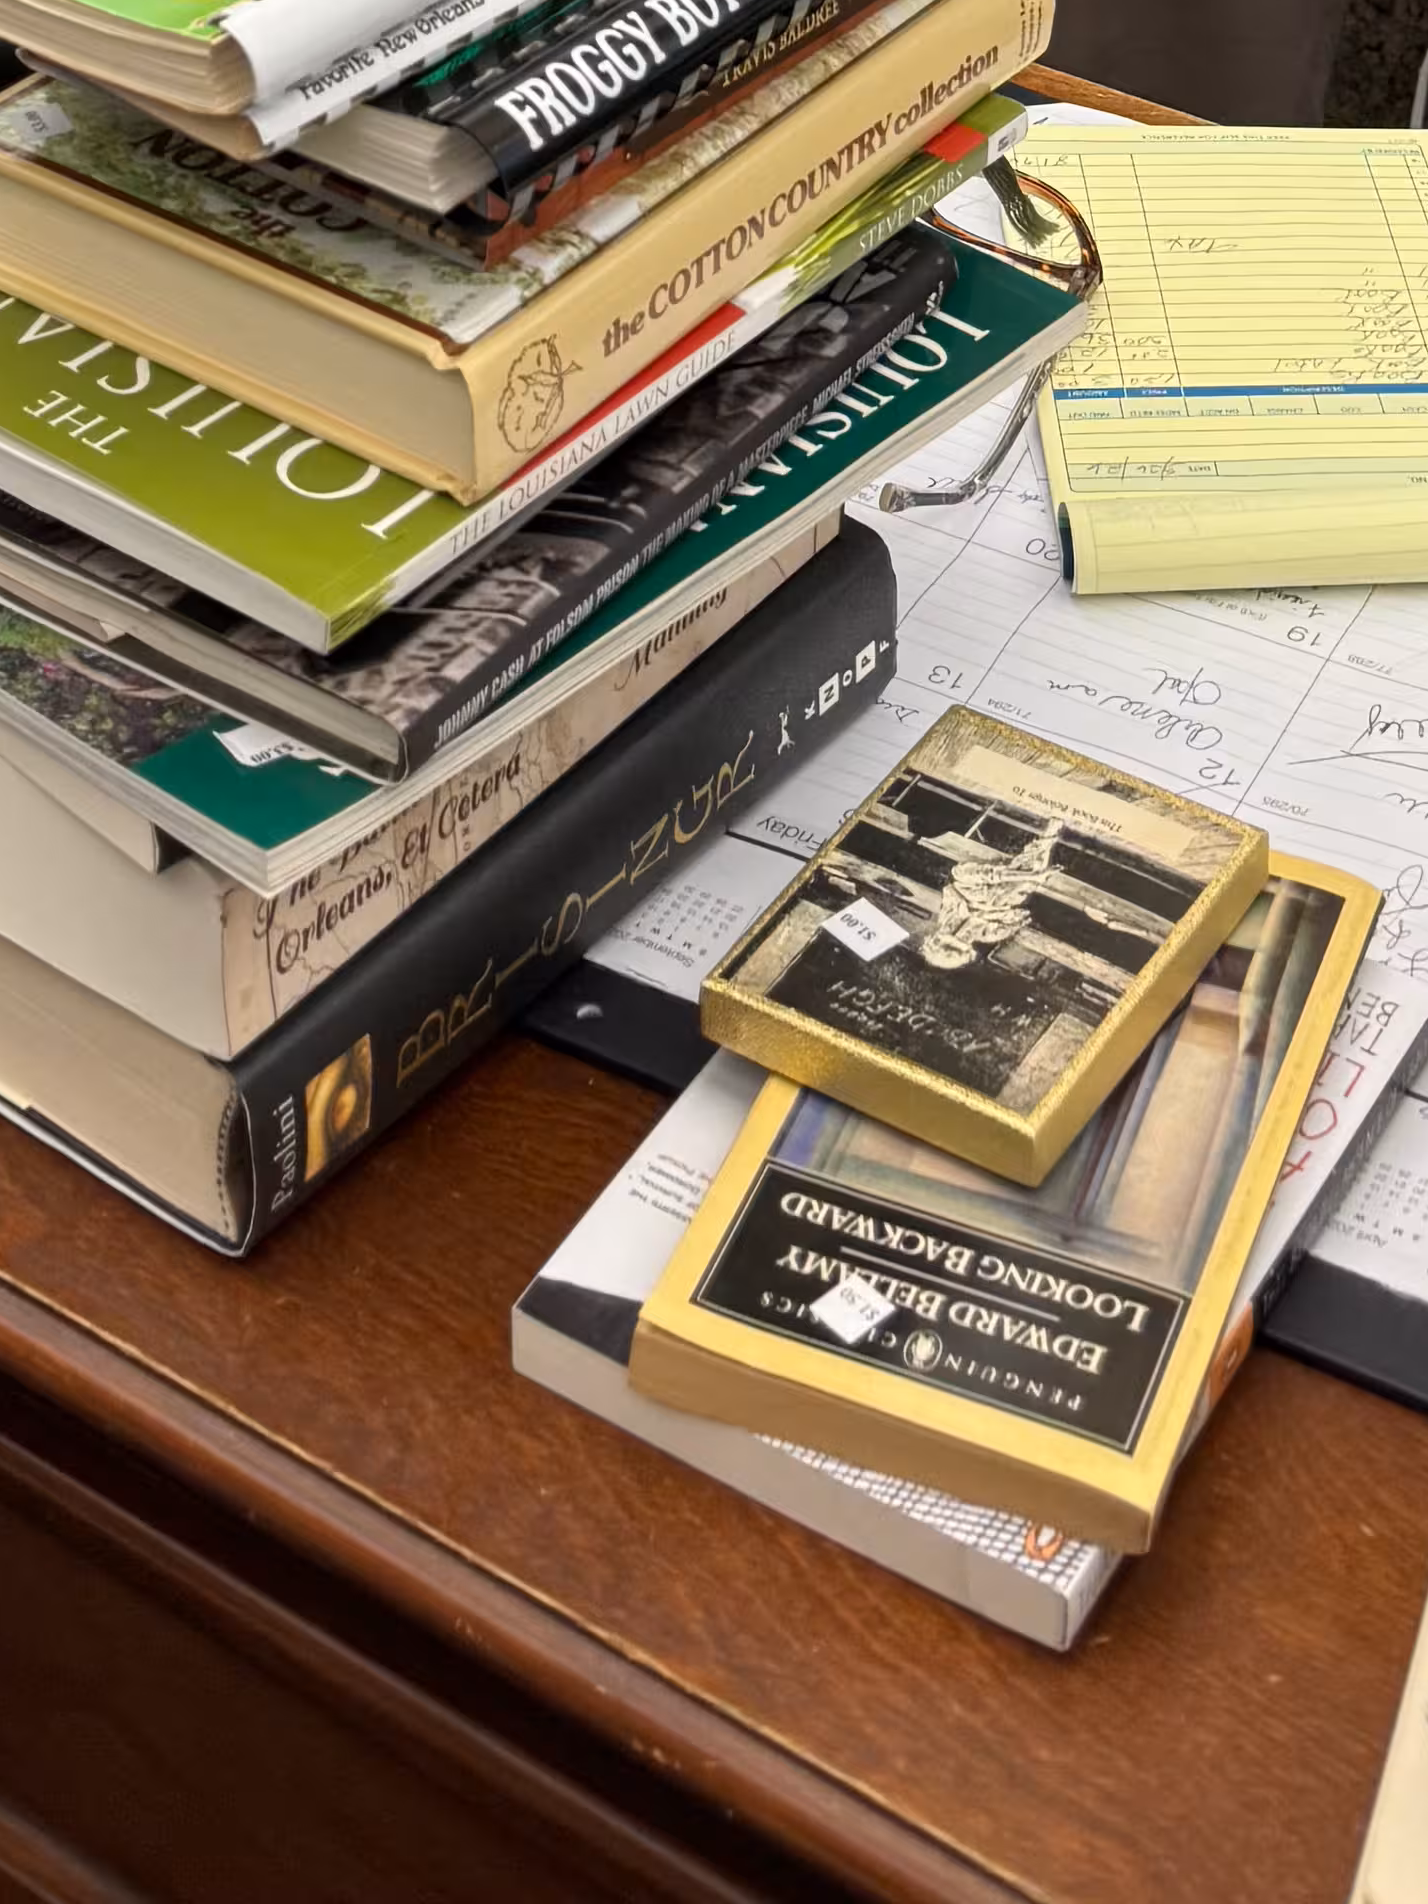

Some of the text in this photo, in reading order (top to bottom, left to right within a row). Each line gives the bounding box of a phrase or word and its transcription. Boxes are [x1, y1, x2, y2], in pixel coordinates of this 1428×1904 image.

[300, 50, 376, 102] Favorite
[379, 29, 418, 59] New
[495, 10, 666, 152] FROGGY
[720, 35, 778, 87] TRAVIS
[602, 42, 1001, 359] the COTTON COUNTRY collection
[857, 161, 966, 253] STEVE DOBBS
[24, 389, 130, 456] THE
[449, 328, 738, 557] THE LOUISIANA LAWN GUIDE
[434, 366, 854, 750] JOHNNY CASH AT FOLSOM PRISON THE MICHAEL
[925, 663, 964, 689] 13
[1287, 623, 1323, 646] 19
[804, 638, 890, 720] KNOPF
[1198, 757, 1242, 787] 12
[274, 866, 394, 975] Orleans,
[435, 751, 523, 840] Cetera
[756, 815, 827, 852] Friday
[395, 728, 756, 1089] BRISINGR
[839, 912, 877, 943] $1.00
[270, 1094, 296, 1214] Paolini
[778, 1191, 1149, 1335] LOOKING BACKWARD
[950, 1288, 1110, 1374] EDWARD
[943, 1351, 1081, 1413] PENGUIN
